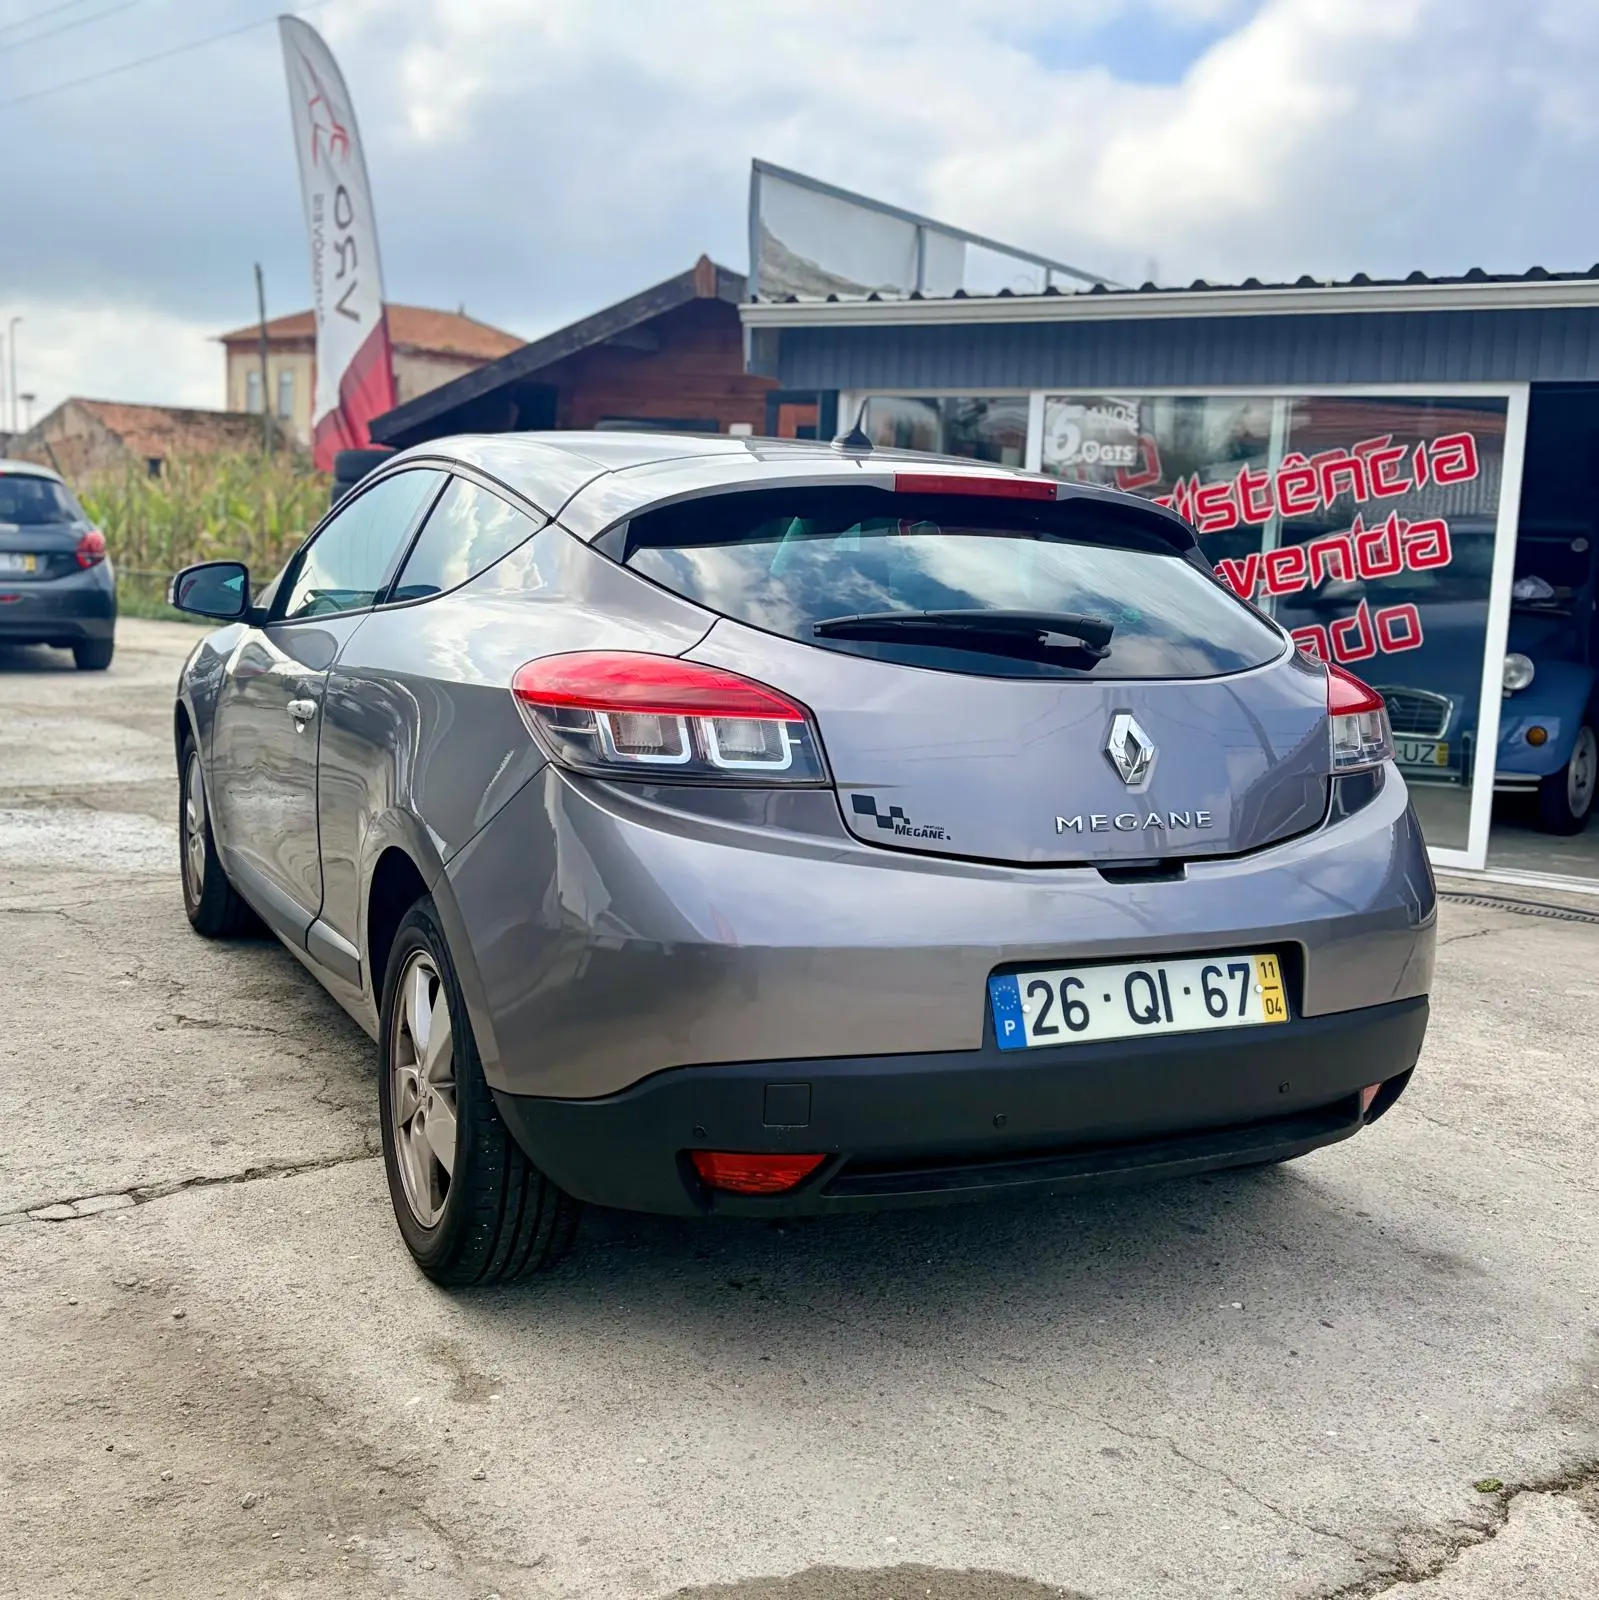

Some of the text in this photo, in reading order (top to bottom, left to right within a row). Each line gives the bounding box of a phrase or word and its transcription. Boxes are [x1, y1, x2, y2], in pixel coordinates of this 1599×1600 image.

[1150, 432, 1479, 533] istência
[1219, 510, 1452, 600] venda
[1290, 597, 1424, 664] ado
[1056, 810, 1213, 834] MEGANE
[1004, 1020, 1016, 1037] P
